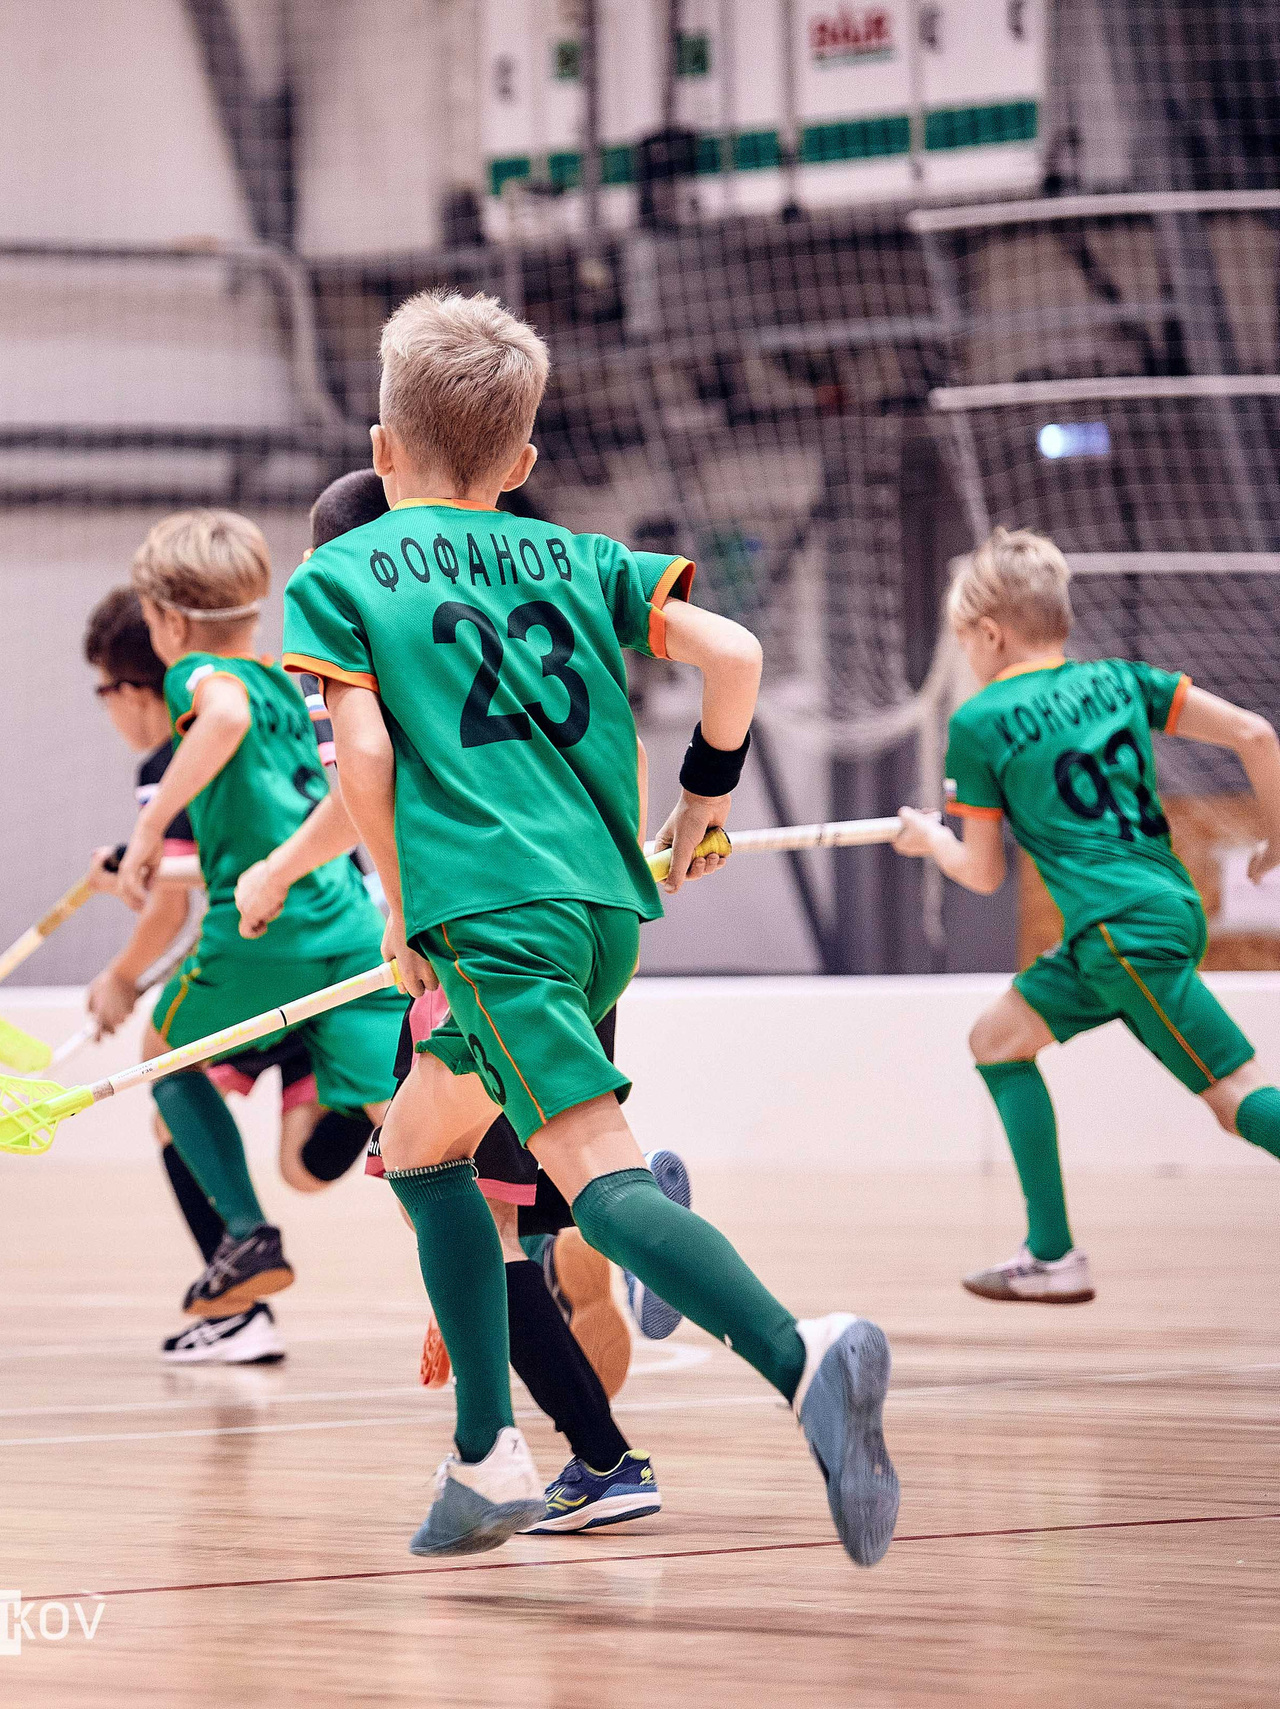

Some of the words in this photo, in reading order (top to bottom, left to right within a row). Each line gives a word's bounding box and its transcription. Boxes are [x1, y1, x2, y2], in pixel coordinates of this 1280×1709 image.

[369, 532, 573, 593] ФОФАНОВ
[432, 600, 591, 749] 23
[1053, 729, 1170, 842] 92
